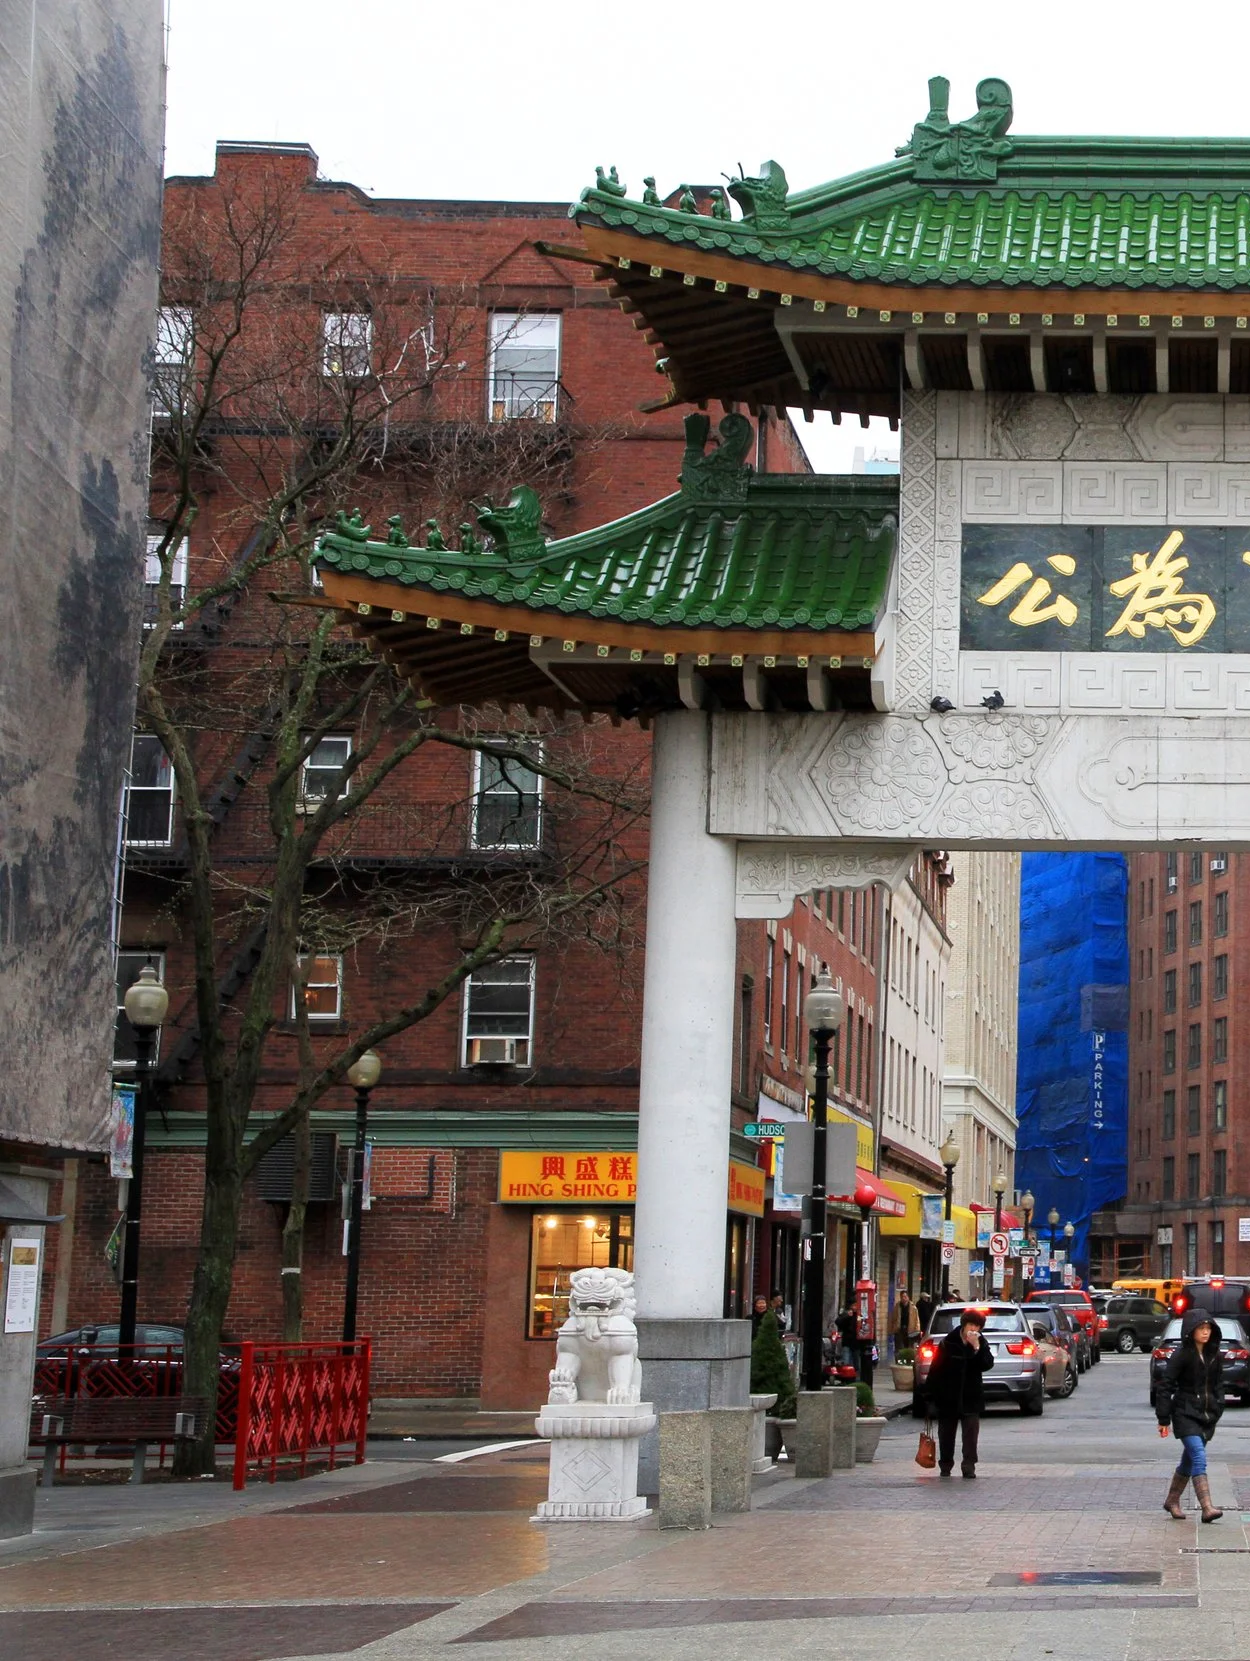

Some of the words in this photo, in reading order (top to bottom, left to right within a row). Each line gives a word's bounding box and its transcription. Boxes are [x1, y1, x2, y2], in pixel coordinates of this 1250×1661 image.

[1094, 1053, 1103, 1118] PARKING
[509, 1183, 553, 1197] HING
[561, 1183, 619, 1197] SHING
